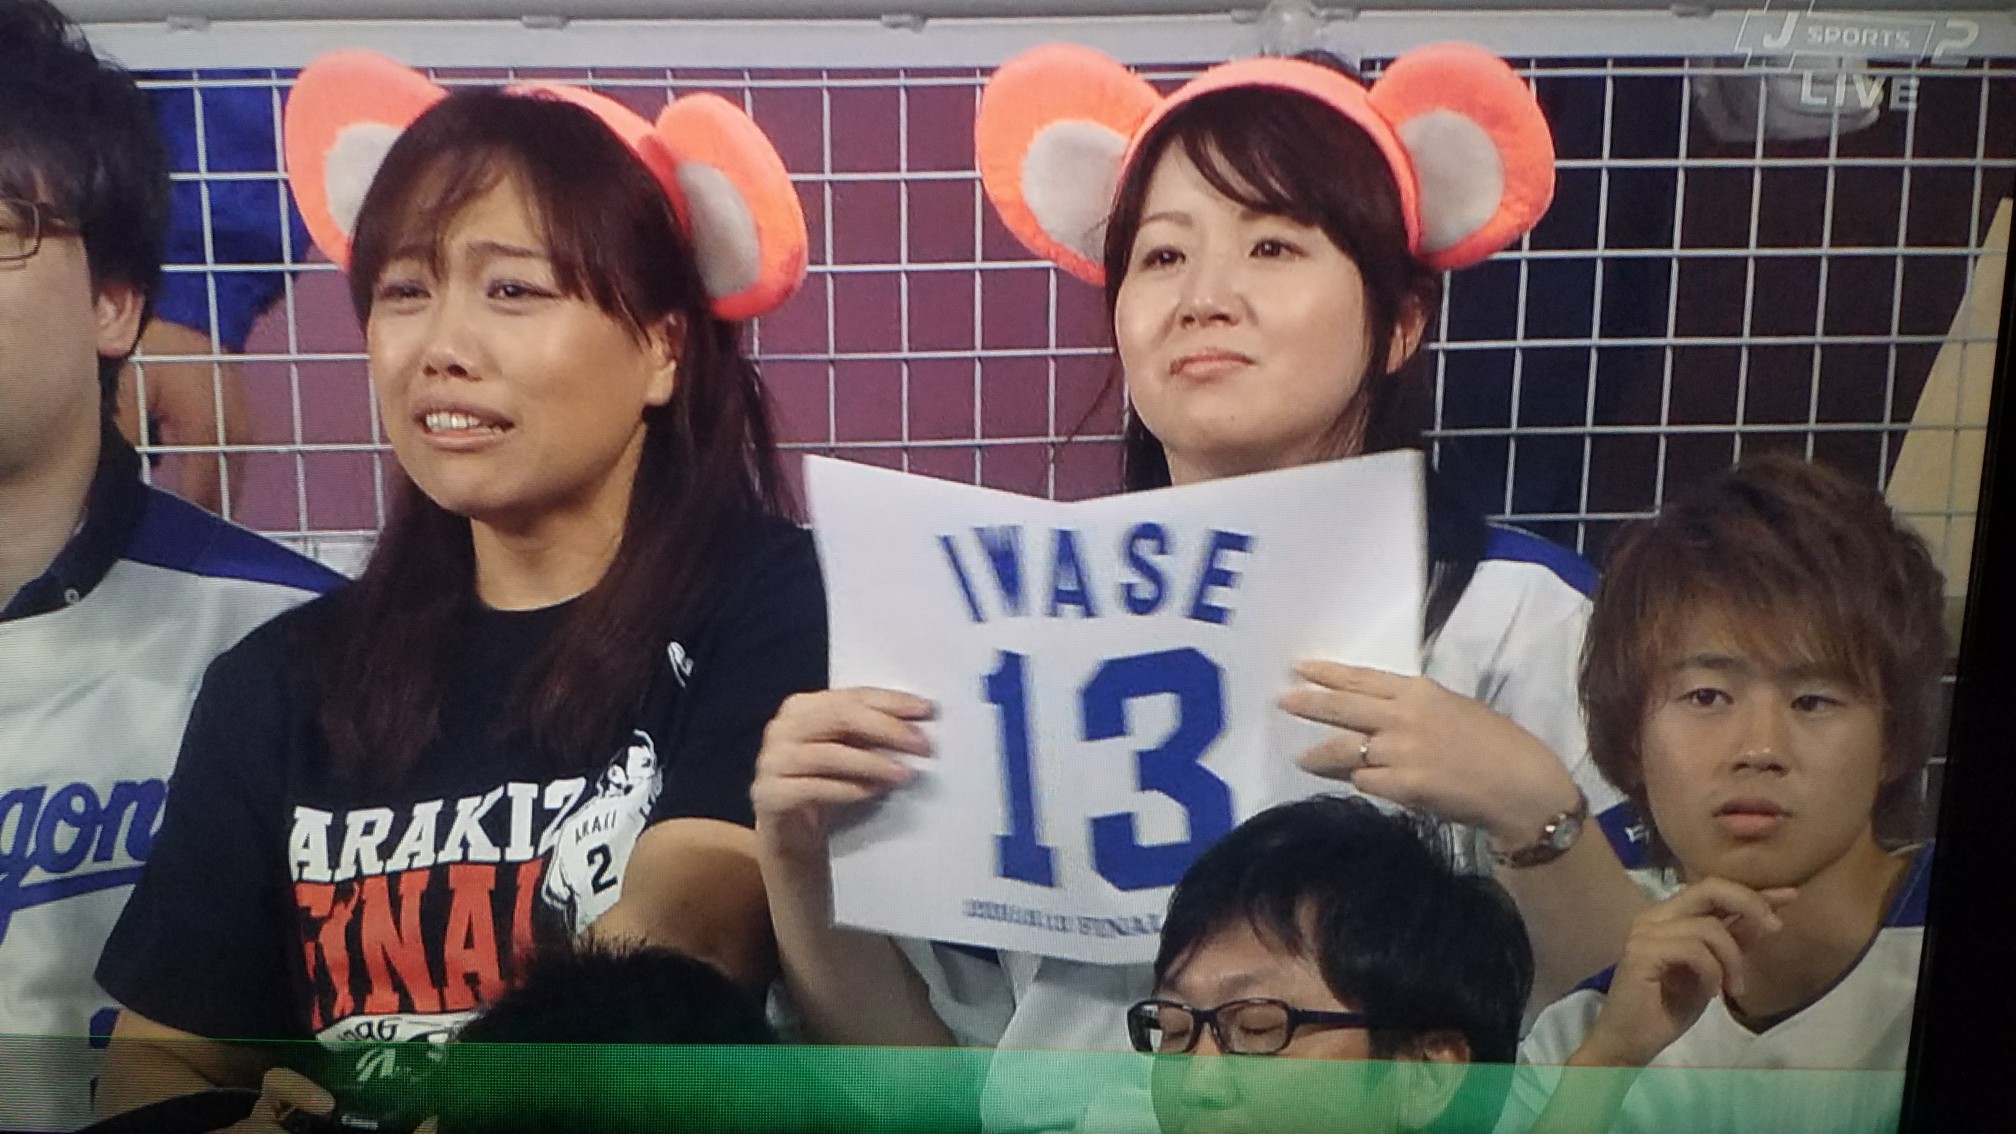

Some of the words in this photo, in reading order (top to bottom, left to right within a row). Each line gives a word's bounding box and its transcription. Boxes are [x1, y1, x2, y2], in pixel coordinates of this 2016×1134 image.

[1762, 11, 1799, 49] J
[1807, 24, 1911, 48] SPORTS
[1930, 19, 1979, 67] 2
[1800, 72, 1919, 111] LIVE
[936, 521, 1254, 625] IWASE
[982, 646, 1236, 892] 13
[586, 842, 620, 895] 2
